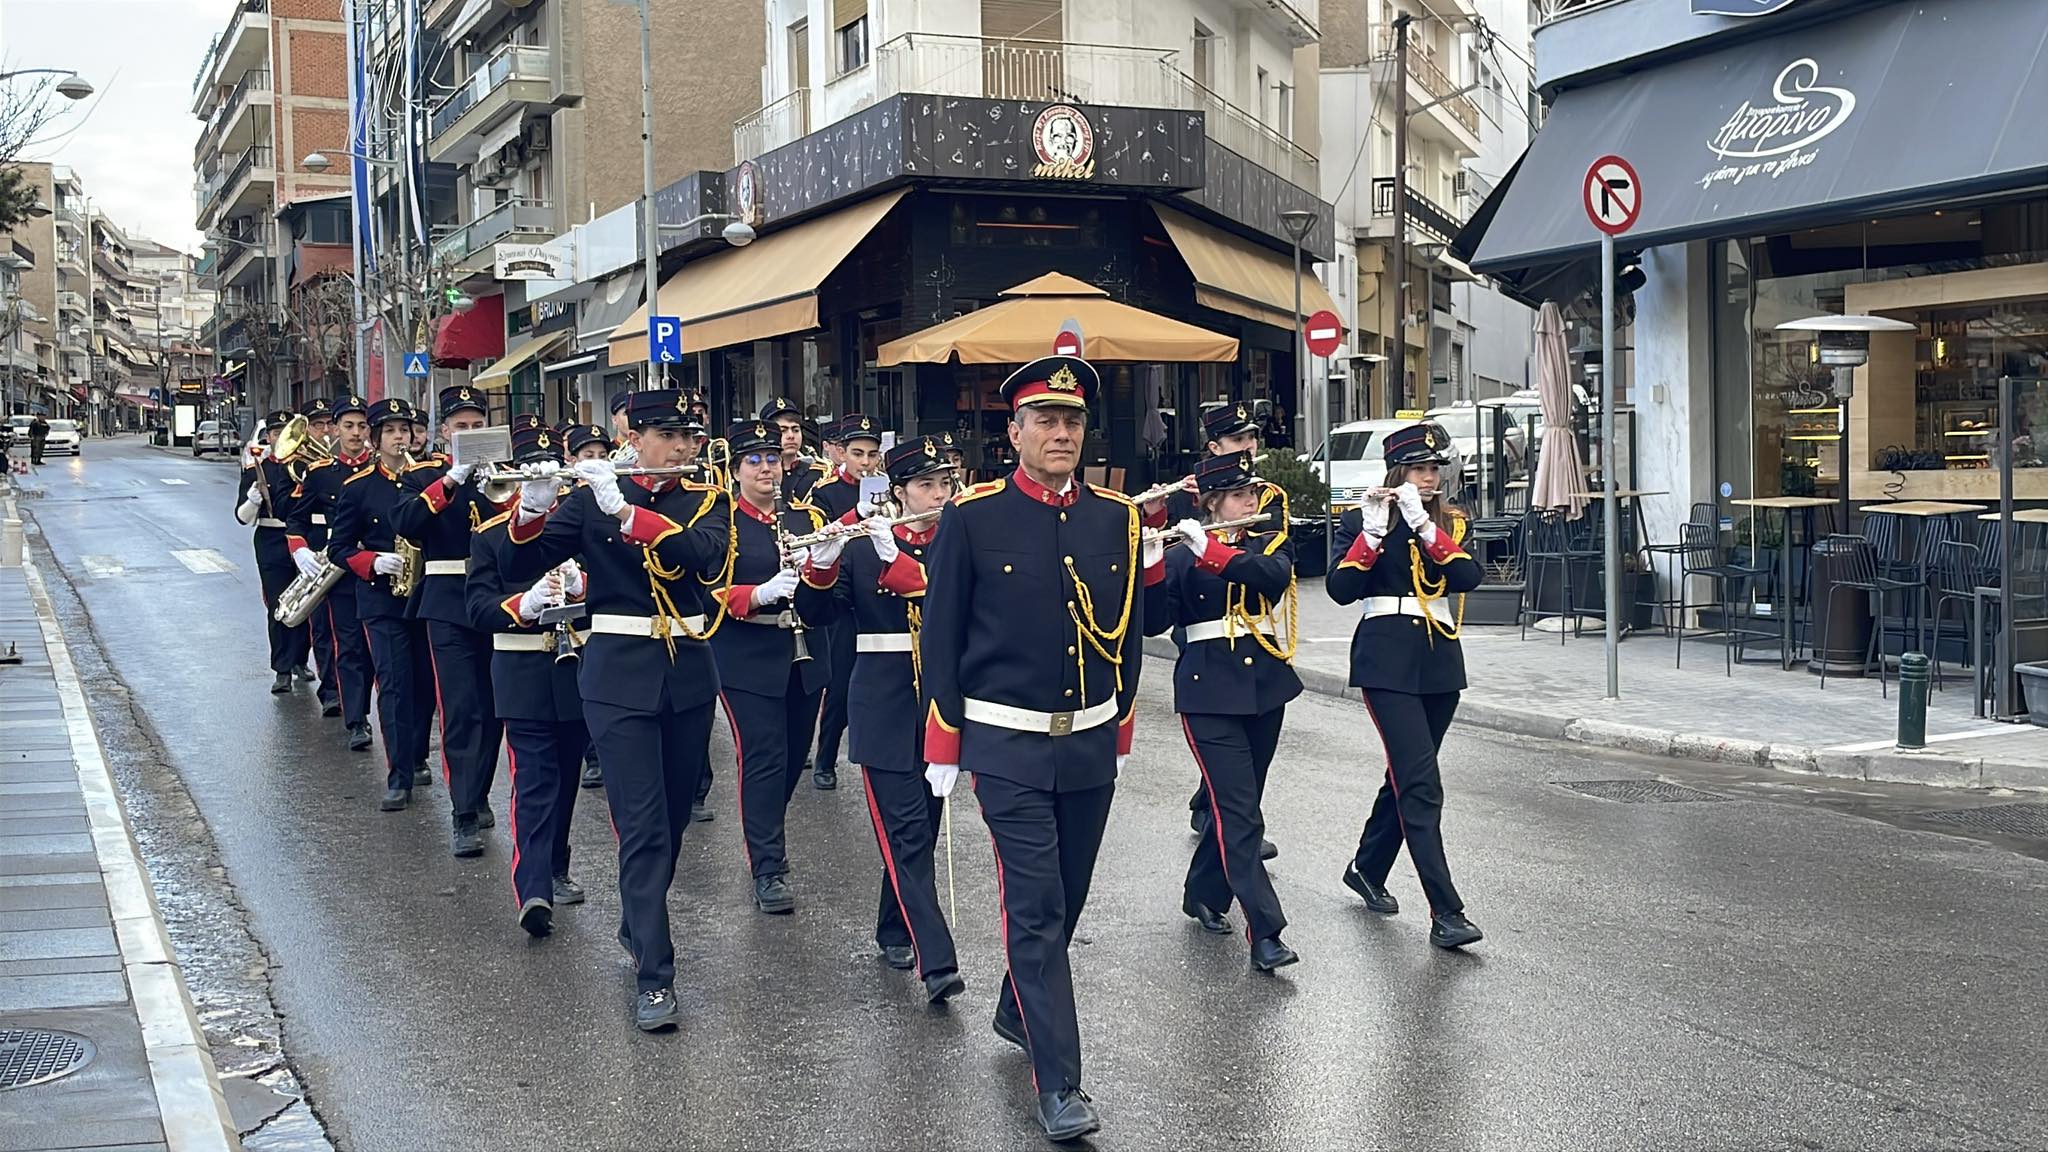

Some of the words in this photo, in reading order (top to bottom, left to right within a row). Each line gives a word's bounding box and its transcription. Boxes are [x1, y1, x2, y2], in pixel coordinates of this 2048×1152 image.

[1713, 101, 1831, 160] Αμορίνο
[1033, 158, 1095, 179] mikel
[657, 322, 673, 343] P
